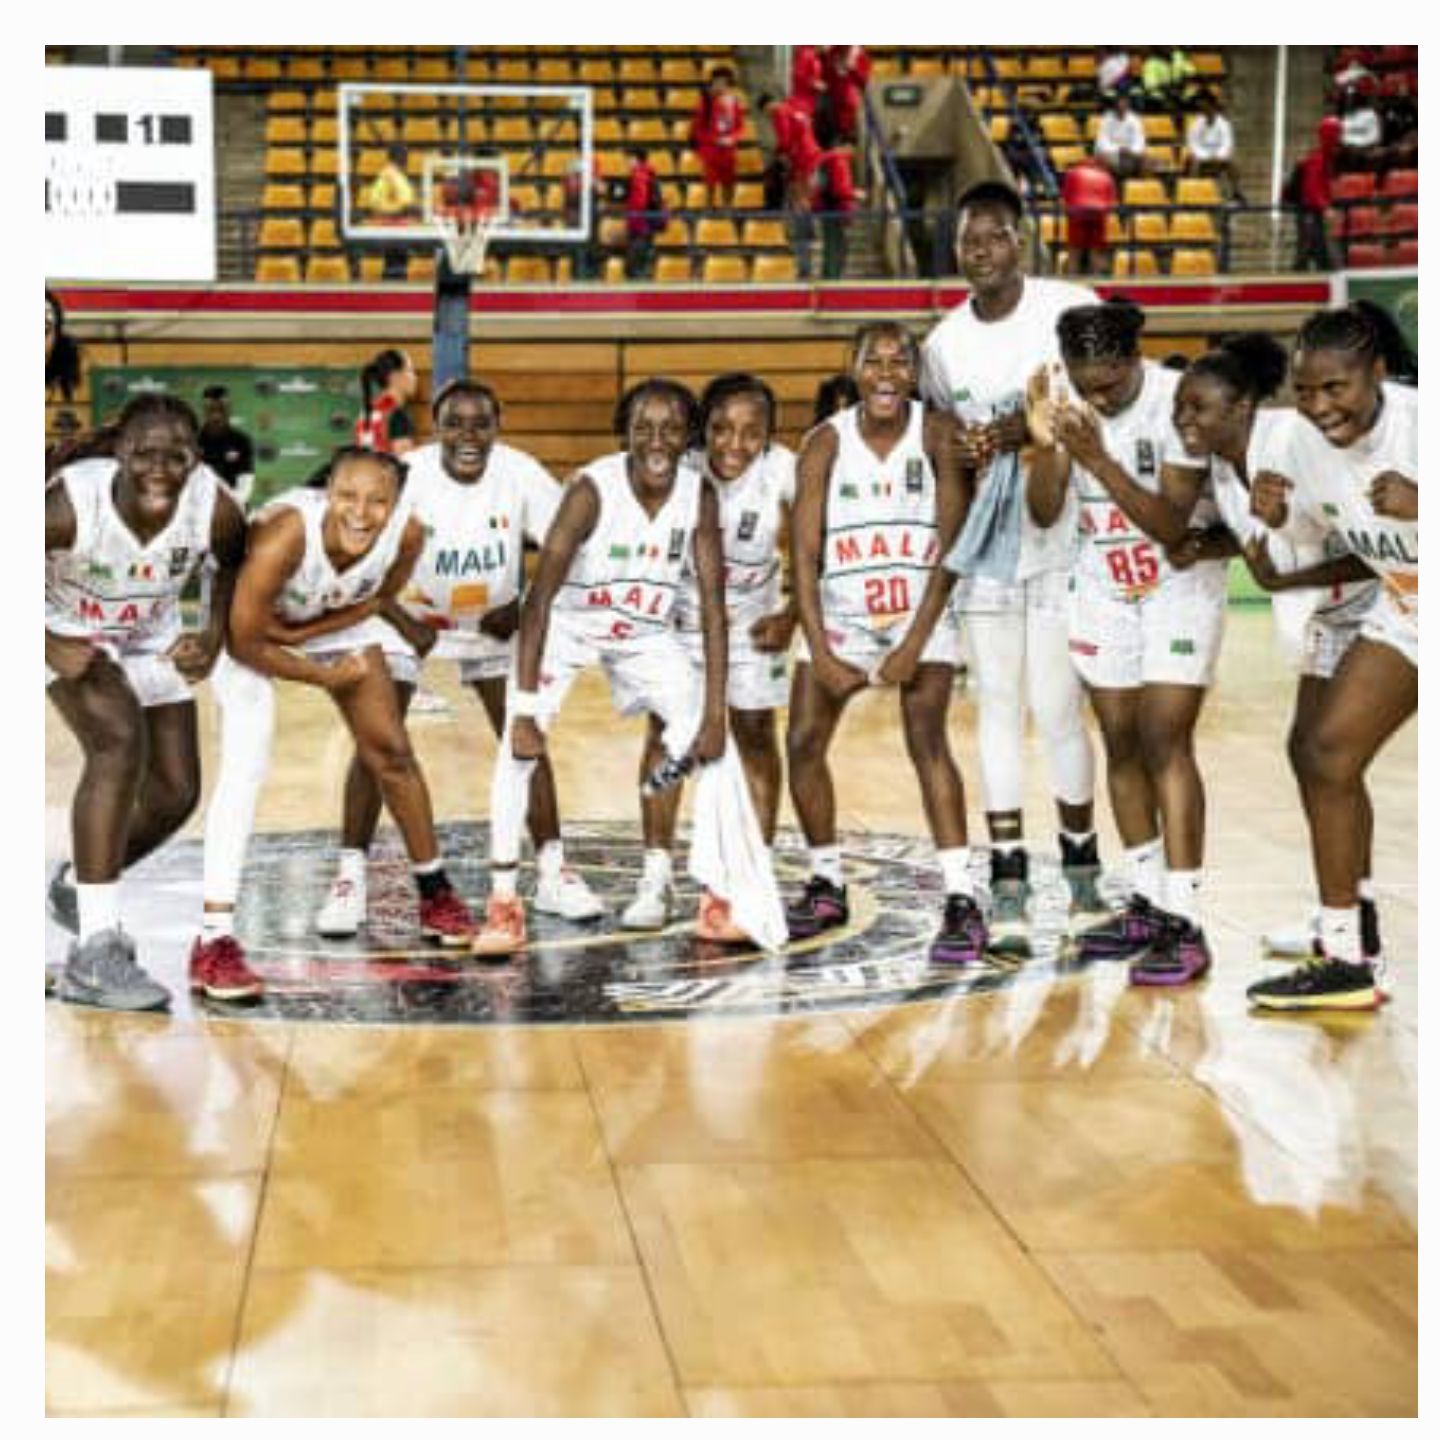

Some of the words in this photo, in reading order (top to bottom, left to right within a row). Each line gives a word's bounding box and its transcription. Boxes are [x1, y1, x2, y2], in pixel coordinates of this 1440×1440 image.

[435, 541, 506, 576] MALI
[836, 528, 941, 564] MALI
[1347, 529, 1418, 564] MAL
[866, 573, 911, 615] 20
